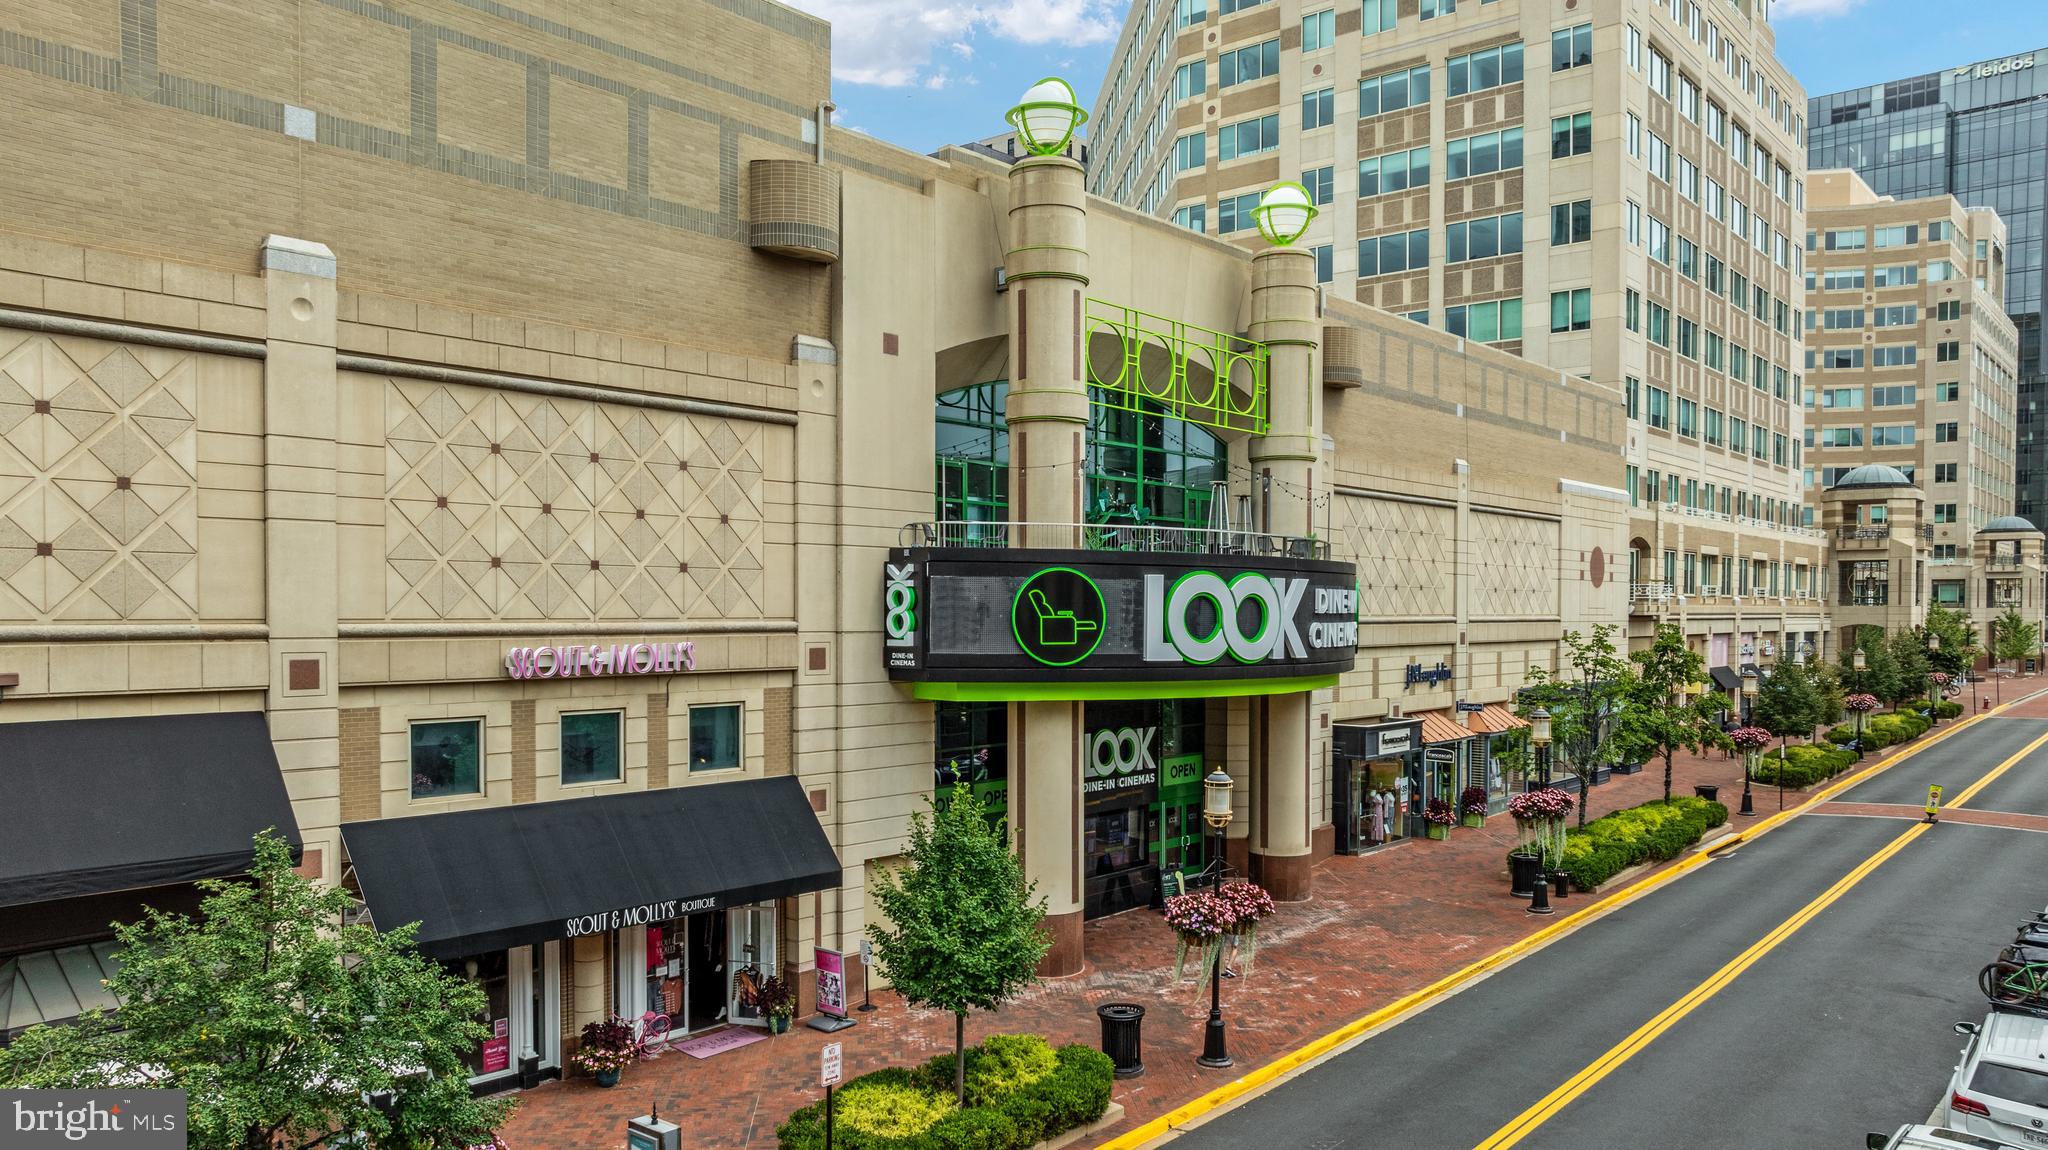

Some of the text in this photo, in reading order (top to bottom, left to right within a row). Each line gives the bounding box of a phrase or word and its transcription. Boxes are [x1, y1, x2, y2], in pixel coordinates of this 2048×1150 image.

[1976, 56, 2034, 78] leidos
[886, 563, 917, 647] LOOK
[1143, 570, 1309, 665] LOOK
[1309, 621, 1357, 648] CINEMA
[509, 641, 697, 679] SCOUT & MOLLY'S
[890, 659, 916, 667] CINEMAS
[1084, 726, 1157, 777] LOOK
[1120, 773, 1156, 788] CINEMAS
[1170, 762, 1196, 779] OPEN
[984, 788, 1008, 806] OPE
[566, 897, 716, 938] SCOUT & MOLLY'S BOUTIQUE
